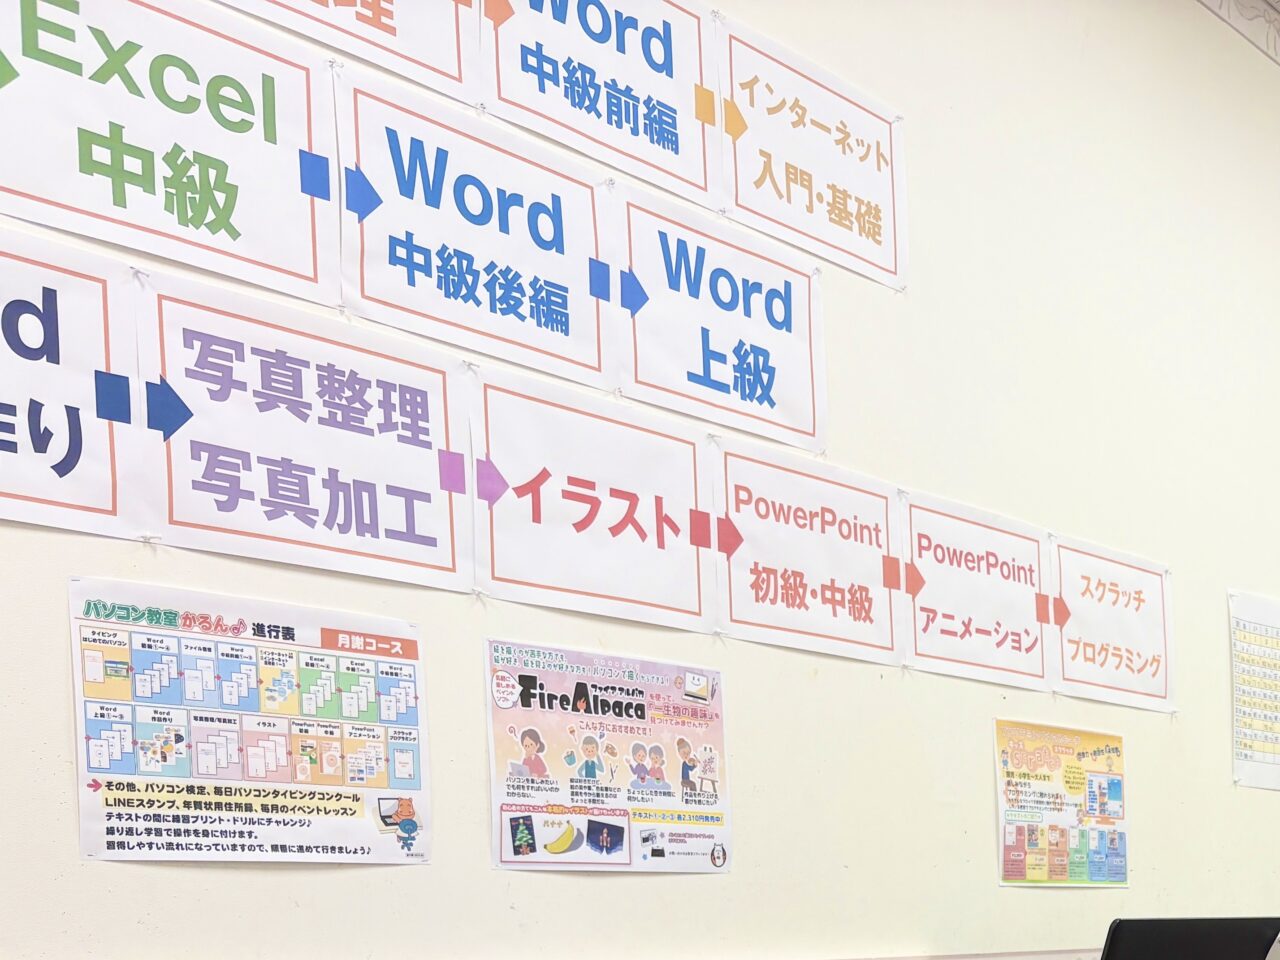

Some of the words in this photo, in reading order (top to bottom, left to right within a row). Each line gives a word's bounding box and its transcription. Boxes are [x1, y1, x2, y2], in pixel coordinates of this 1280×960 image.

[20, 0, 277, 145] Excel
[520, 41, 679, 155] 中級前編
[739, 75, 889, 172] インターネット
[77, 121, 241, 241] 中級
[385, 126, 564, 255] Word
[753, 149, 882, 246] 入門・基礎
[388, 230, 569, 336] 中級後編
[657, 230, 792, 333] Word
[182, 328, 432, 450] 写真整理
[686, 327, 776, 409] 上級
[189, 440, 437, 547] 写真加工
[512, 467, 681, 550] イラスト
[734, 484, 882, 549] PowerPoint
[749, 561, 873, 624] 初級・中級
[917, 533, 1035, 587] PowerPoint
[1080, 575, 1145, 613] スクラッチ
[252, 622, 296, 642] 進行表
[338, 633, 403, 655] 月謝コース
[919, 606, 1038, 654] アニメーション
[1067, 637, 1161, 678] プログラミング
[518, 674, 646, 720] FireAlpaca
